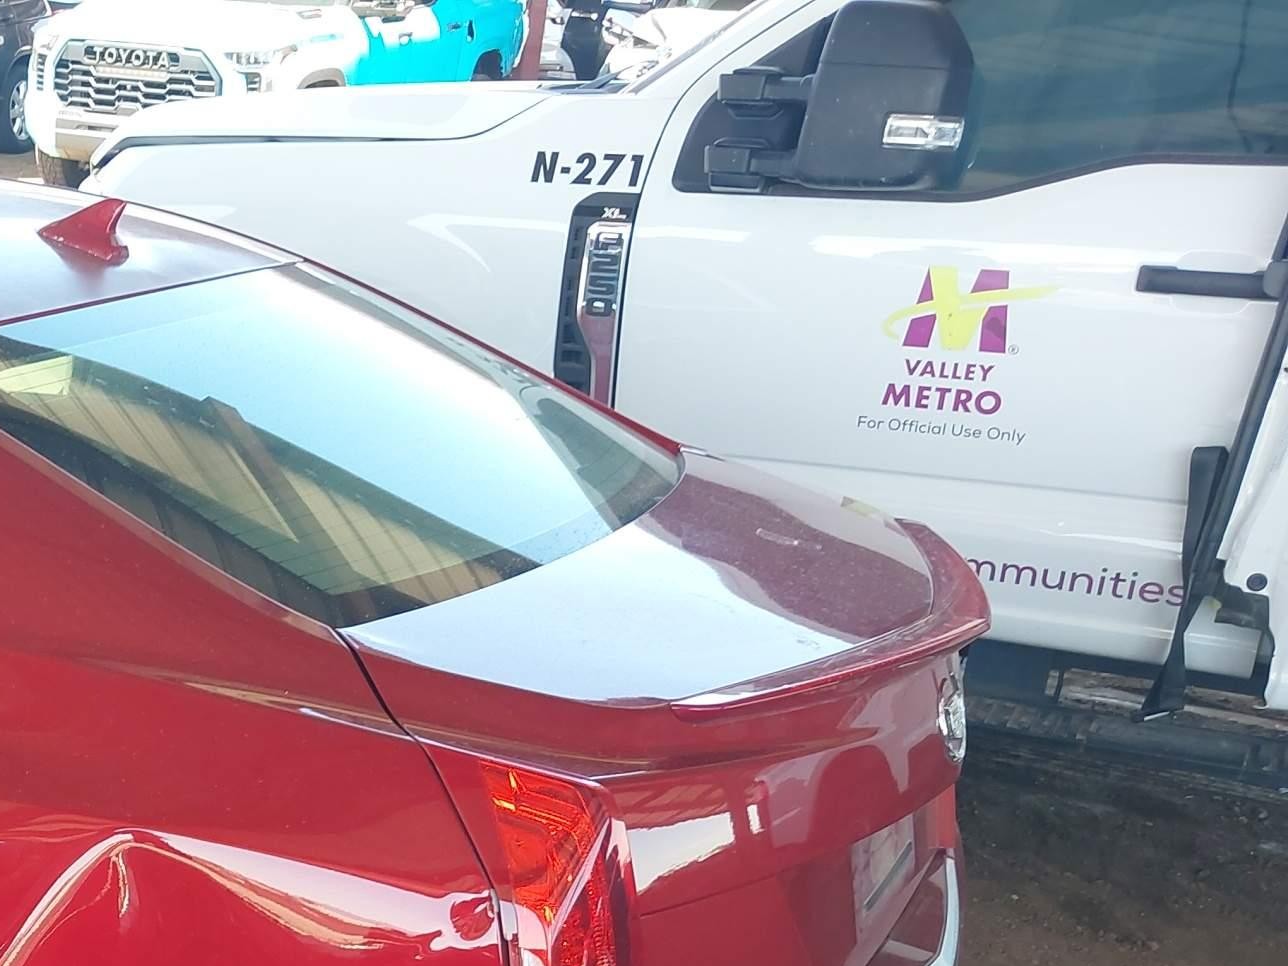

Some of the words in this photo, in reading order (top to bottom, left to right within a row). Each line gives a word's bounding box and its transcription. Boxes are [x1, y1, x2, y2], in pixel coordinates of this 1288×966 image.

[92, 46, 170, 69] TOYOTA
[530, 151, 645, 188] N-271
[602, 207, 628, 220] XL
[904, 358, 995, 382] VALLEY
[880, 382, 1003, 415] METRO
[856, 415, 885, 430] For
[888, 418, 947, 436] Official
[951, 424, 982, 439] Use
[986, 427, 1026, 446] Only
